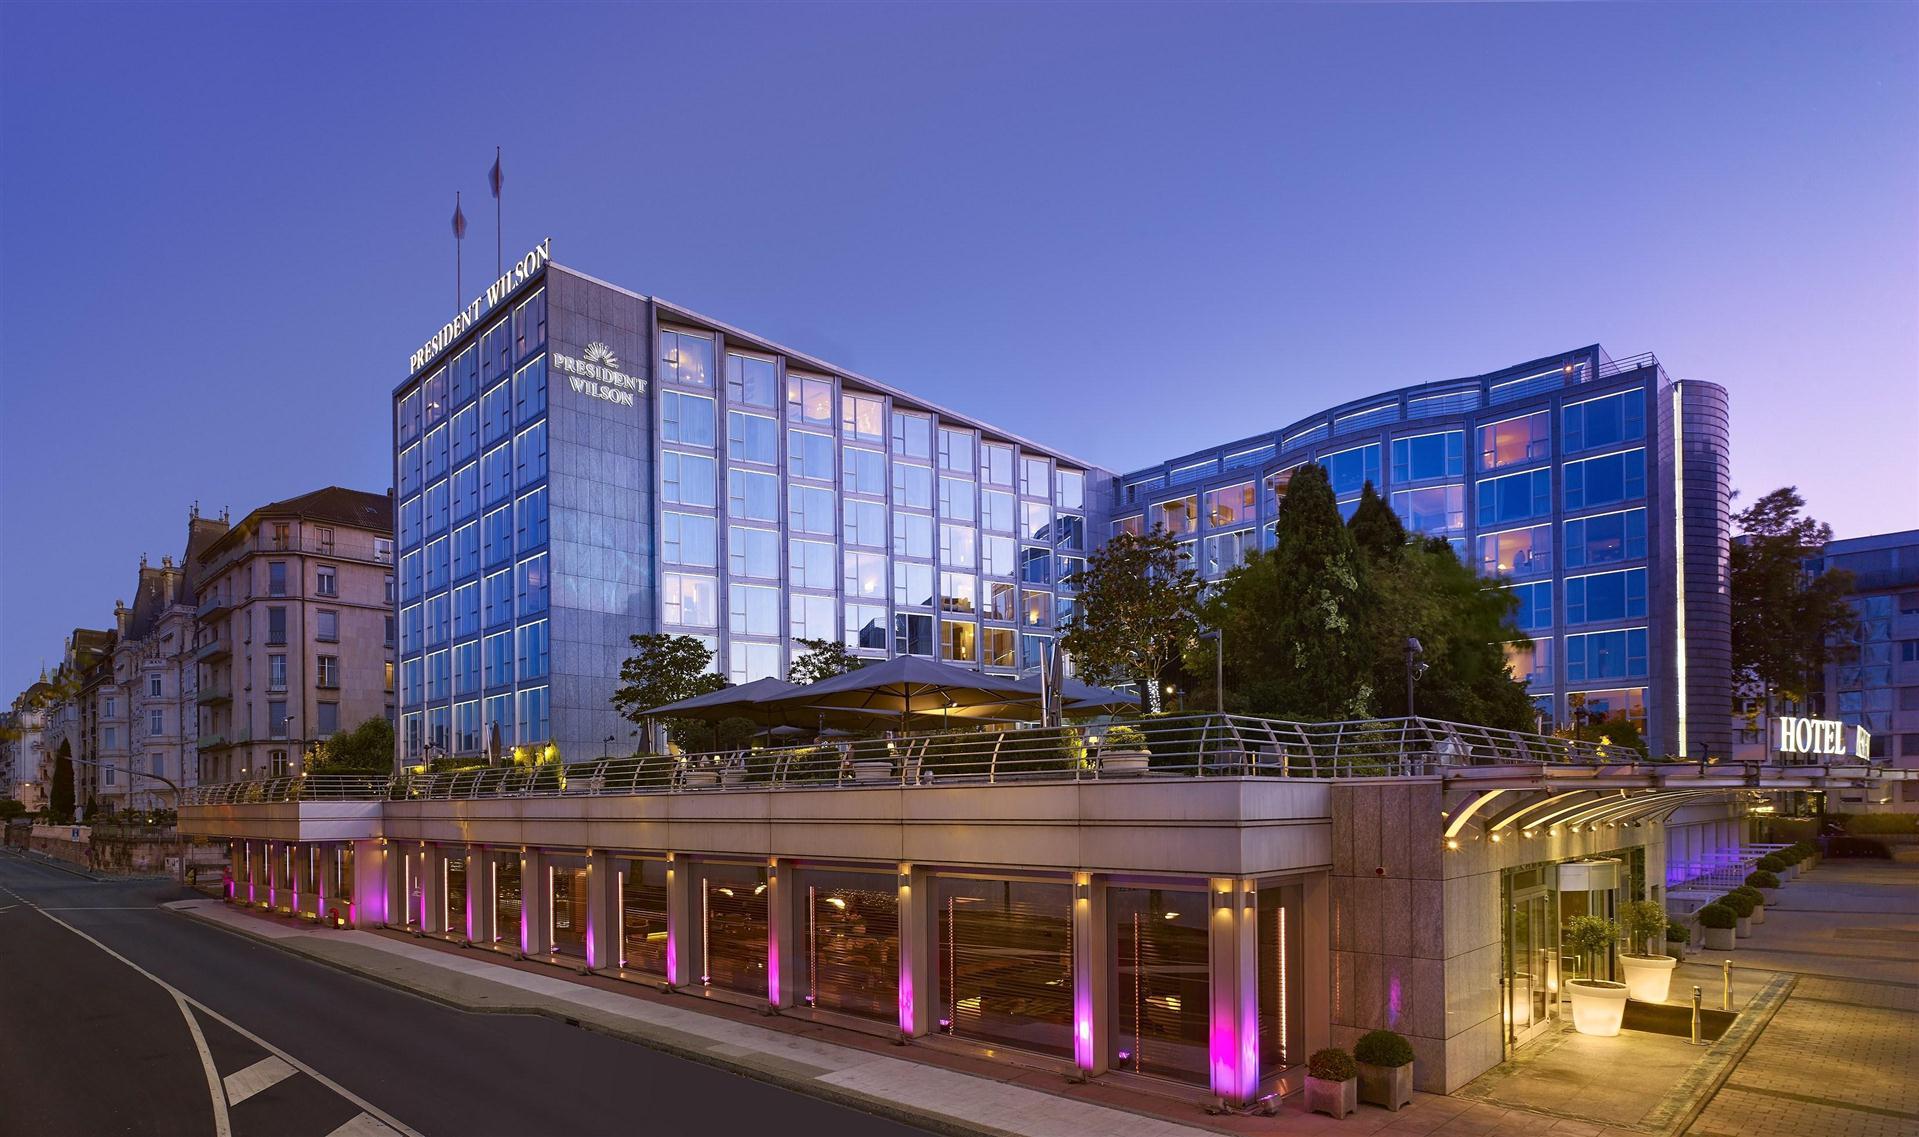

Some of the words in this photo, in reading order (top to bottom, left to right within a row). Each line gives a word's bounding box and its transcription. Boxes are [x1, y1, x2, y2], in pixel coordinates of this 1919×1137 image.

[410, 296, 482, 374] PRESIDENT
[486, 237, 551, 308] WILSON
[553, 352, 648, 394] PRESIDENT
[568, 376, 635, 408] WILSON
[1780, 716, 1846, 755] HOTEL
